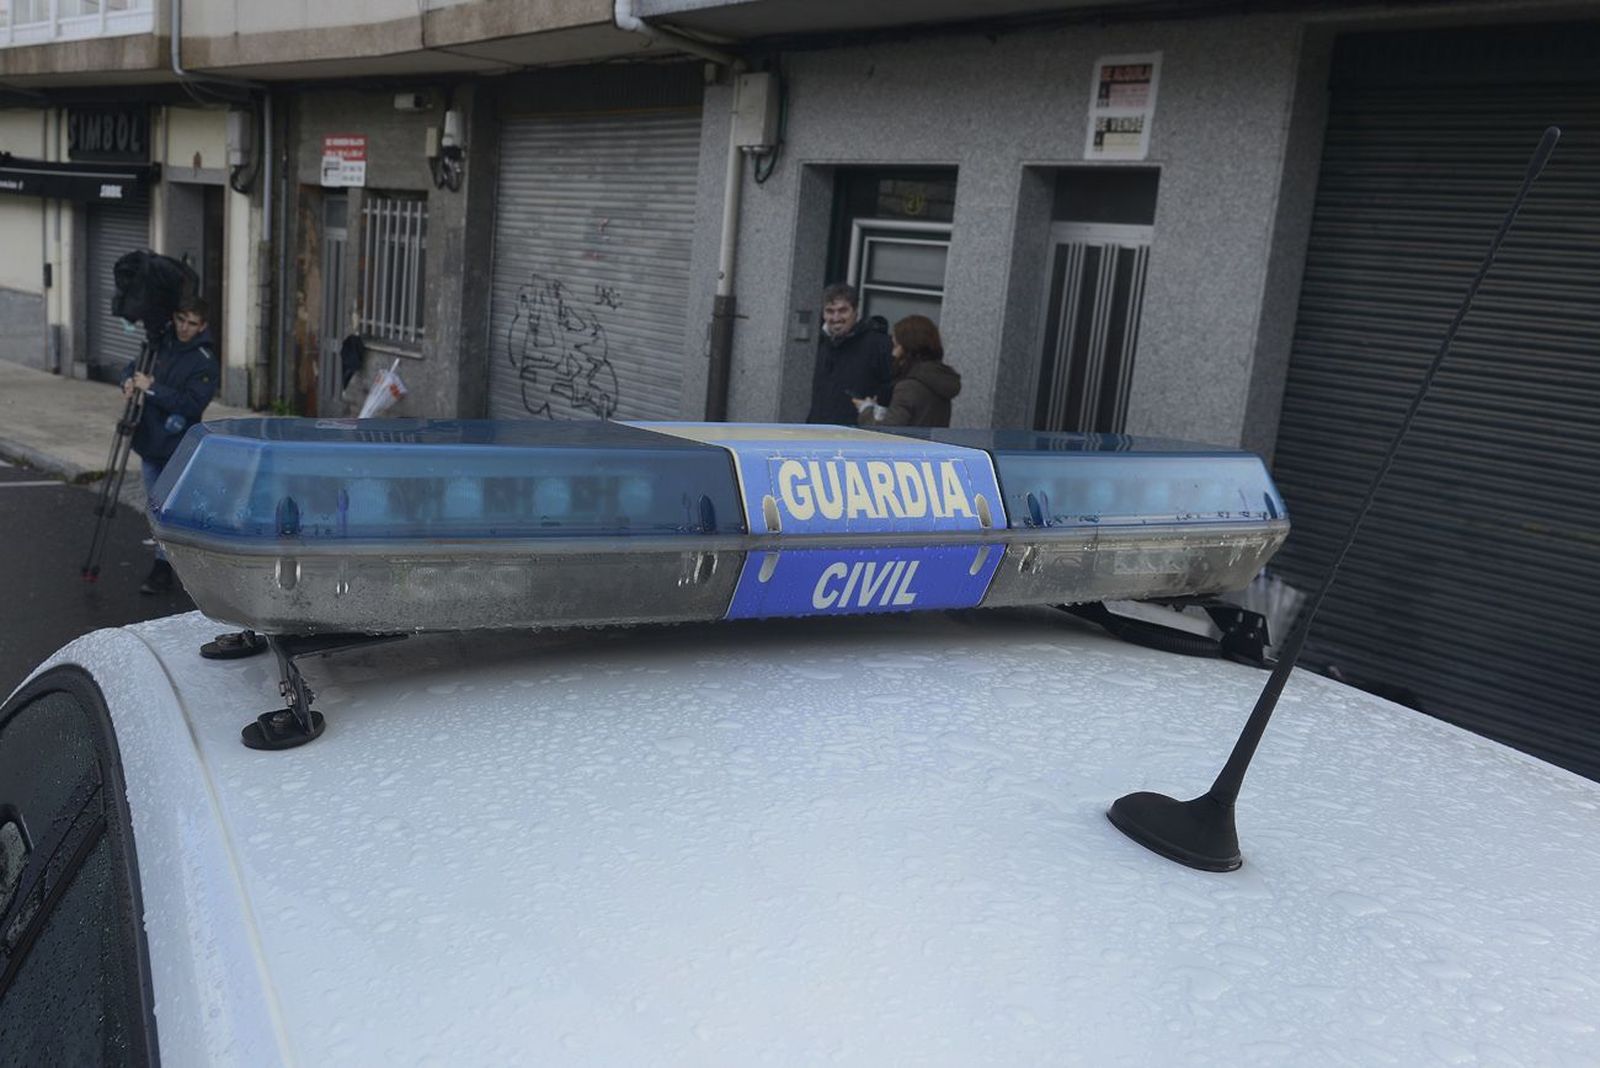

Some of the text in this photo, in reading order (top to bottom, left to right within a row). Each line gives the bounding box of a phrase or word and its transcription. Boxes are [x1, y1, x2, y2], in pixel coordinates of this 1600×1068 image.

[69, 113, 140, 152] SIMBOL
[778, 460, 973, 520] GUARDIA
[811, 559, 920, 610] CIVIL
